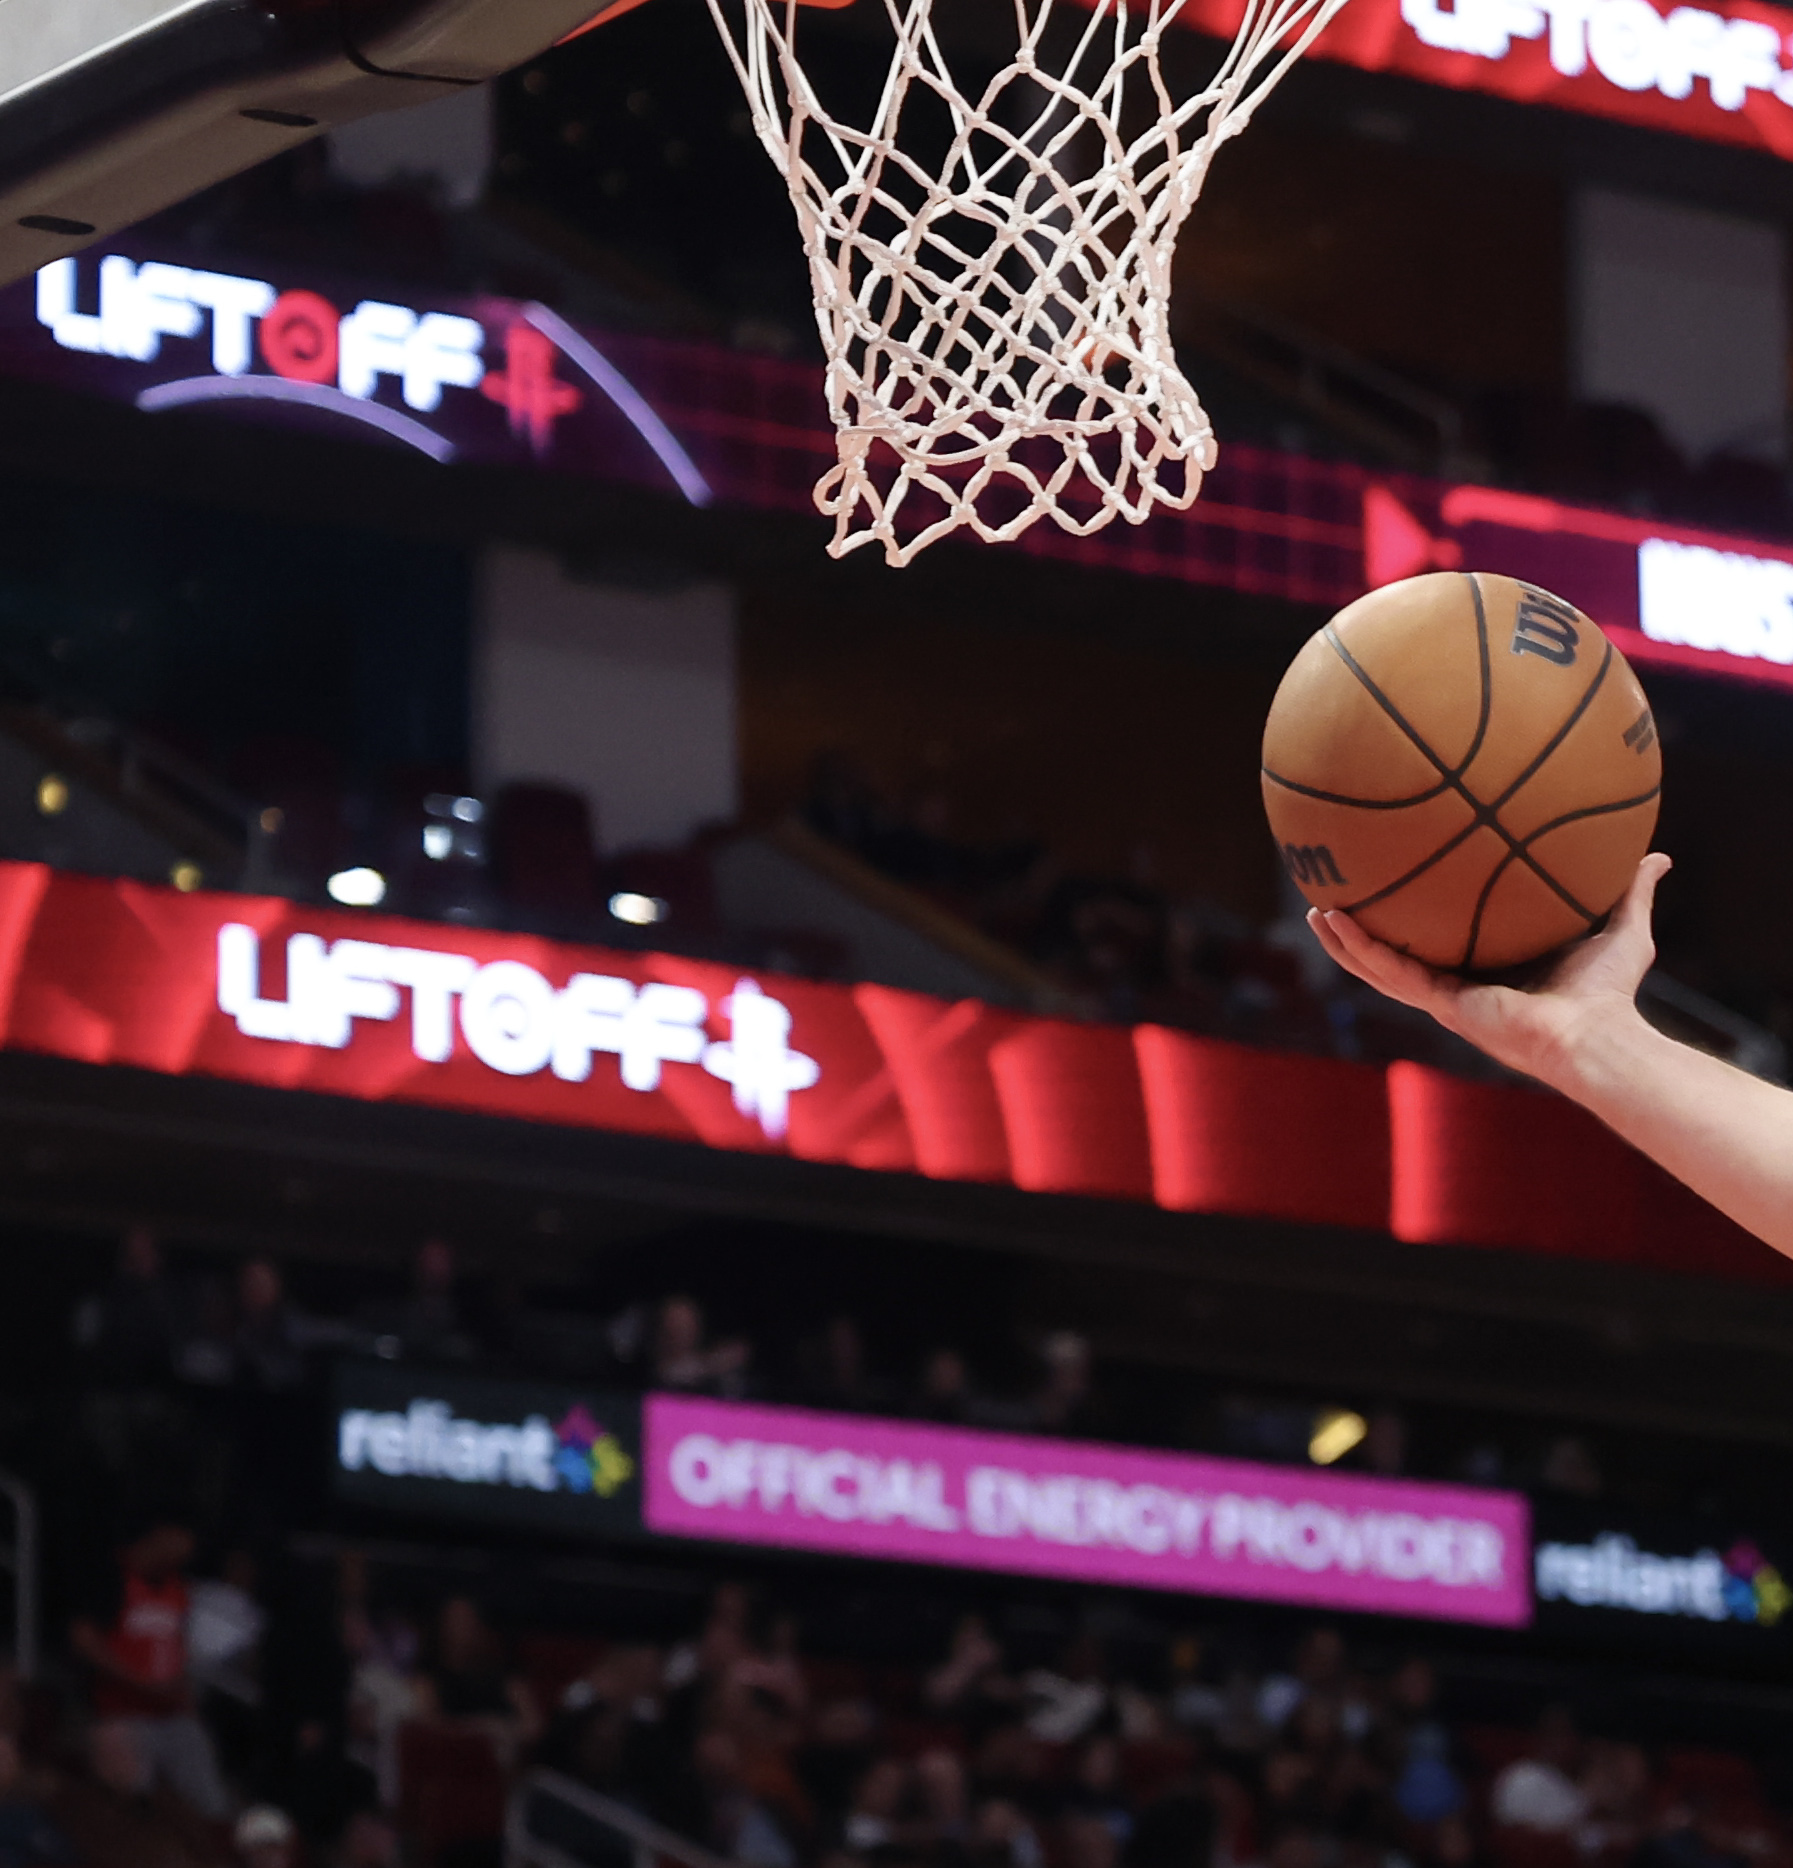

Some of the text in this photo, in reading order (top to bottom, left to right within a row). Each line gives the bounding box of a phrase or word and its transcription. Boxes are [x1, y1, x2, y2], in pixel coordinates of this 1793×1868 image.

[37, 254, 485, 412] LIFTOFF
[217, 922, 709, 1092] LIFTOFF
[339, 1397, 559, 1492] reliant
[667, 1432, 1505, 1591] OFFICIAL ENERGY PROVIDER
[1535, 1530, 1731, 1621] reliant
